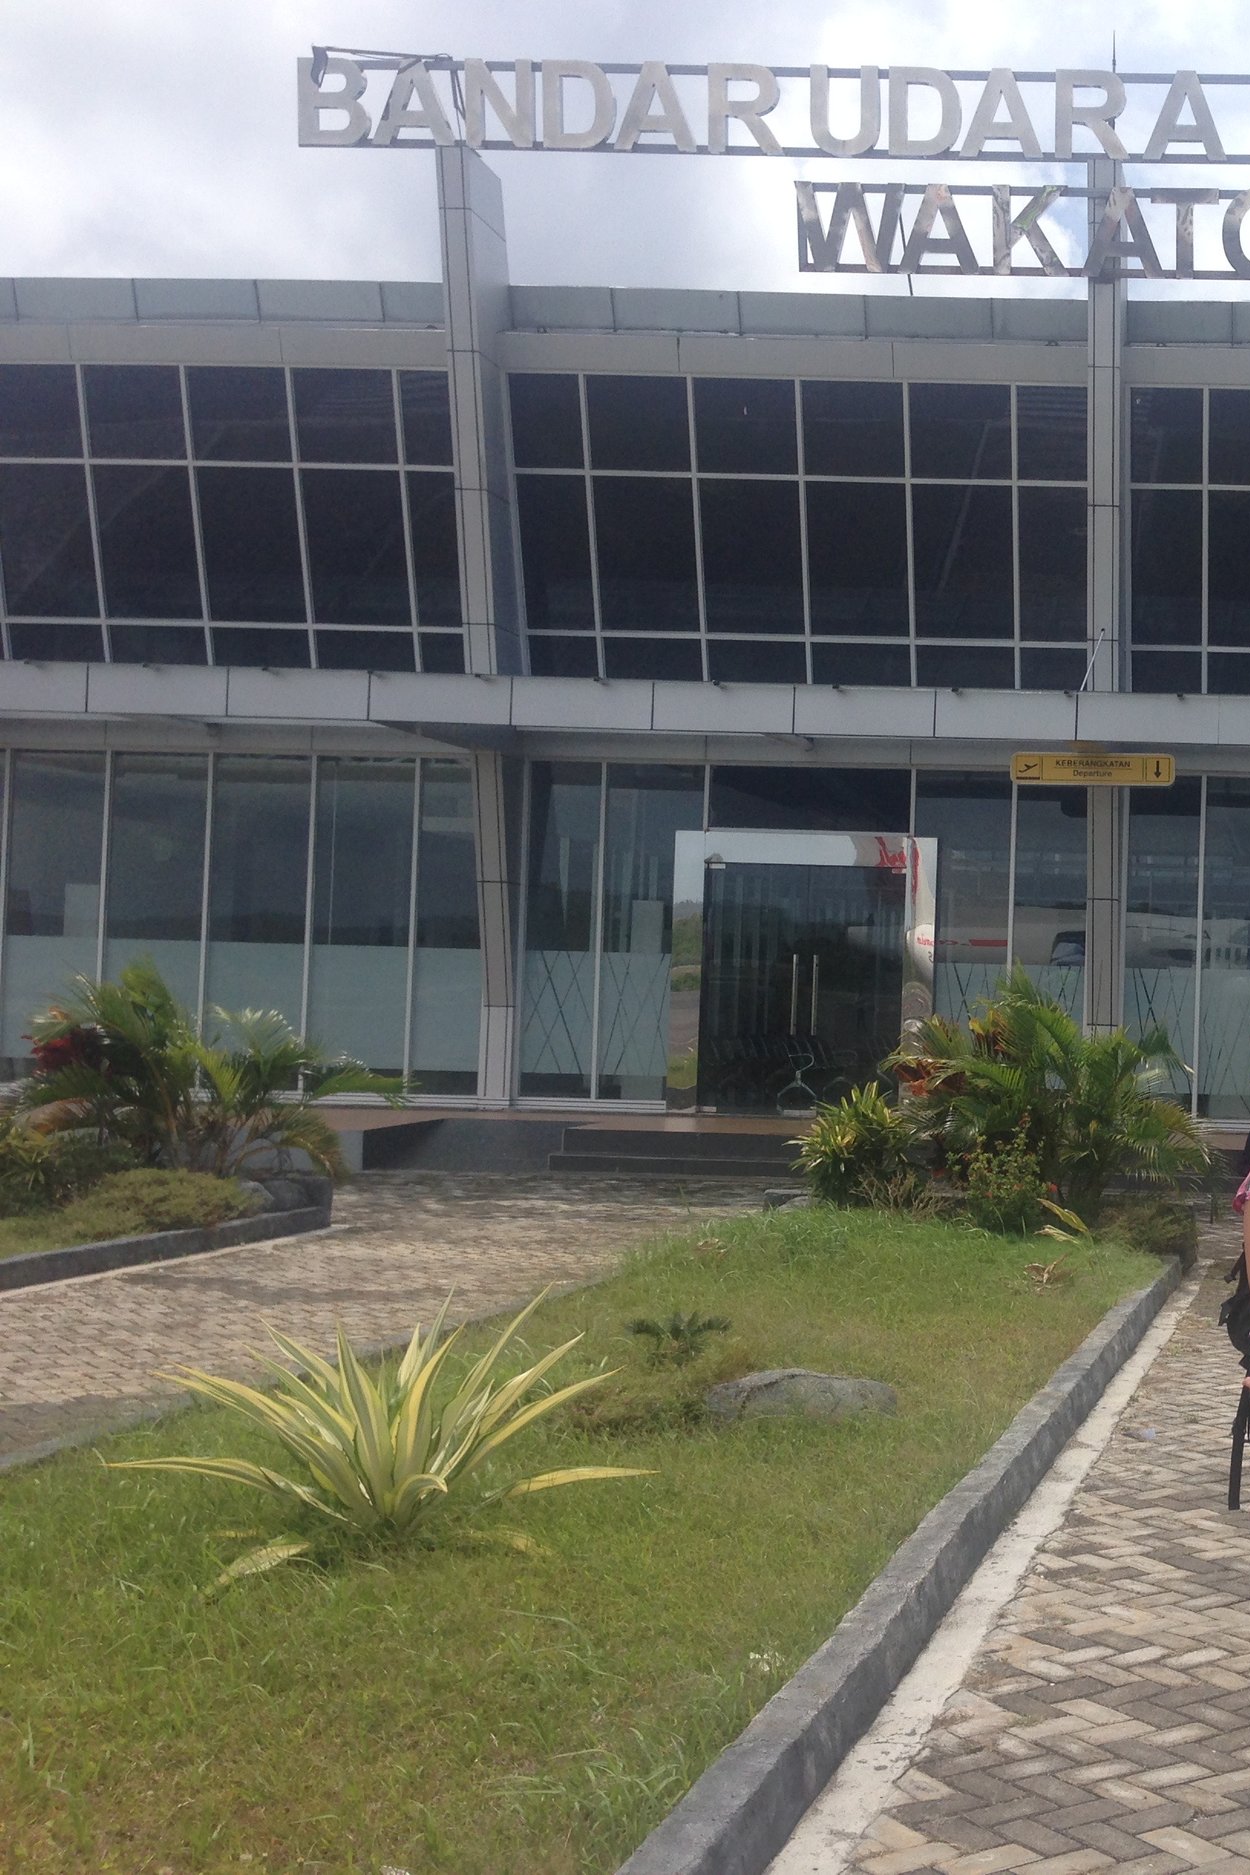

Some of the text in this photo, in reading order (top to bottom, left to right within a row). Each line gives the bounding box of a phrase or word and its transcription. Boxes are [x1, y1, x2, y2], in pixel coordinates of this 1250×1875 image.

[298, 57, 783, 156] BANDAR
[810, 64, 1226, 161] UDARA
[1073, 769, 1112, 778] Departure
